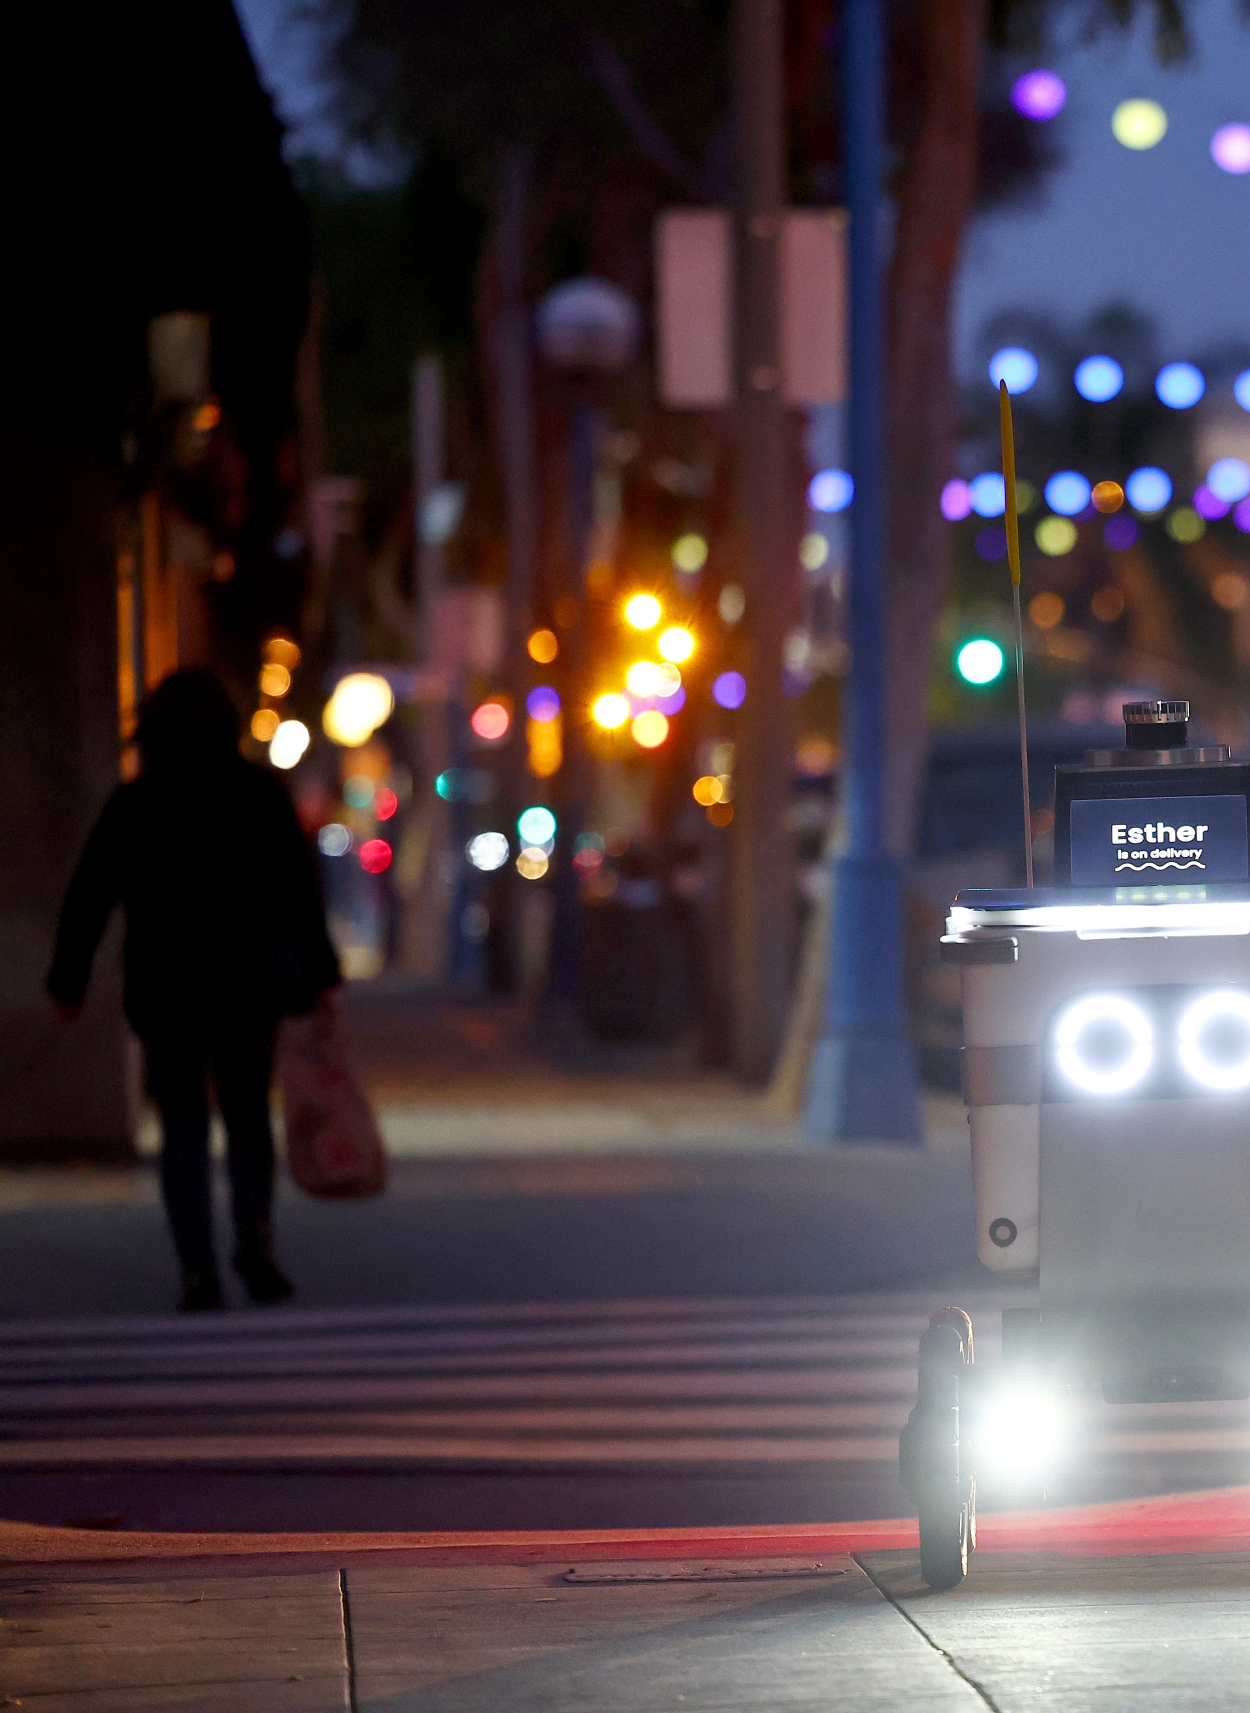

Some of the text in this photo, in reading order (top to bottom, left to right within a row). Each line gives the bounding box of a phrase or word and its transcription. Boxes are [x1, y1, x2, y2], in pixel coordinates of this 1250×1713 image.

[1111, 822, 1208, 844] Esther
[1117, 848, 1203, 860] is on delivery
